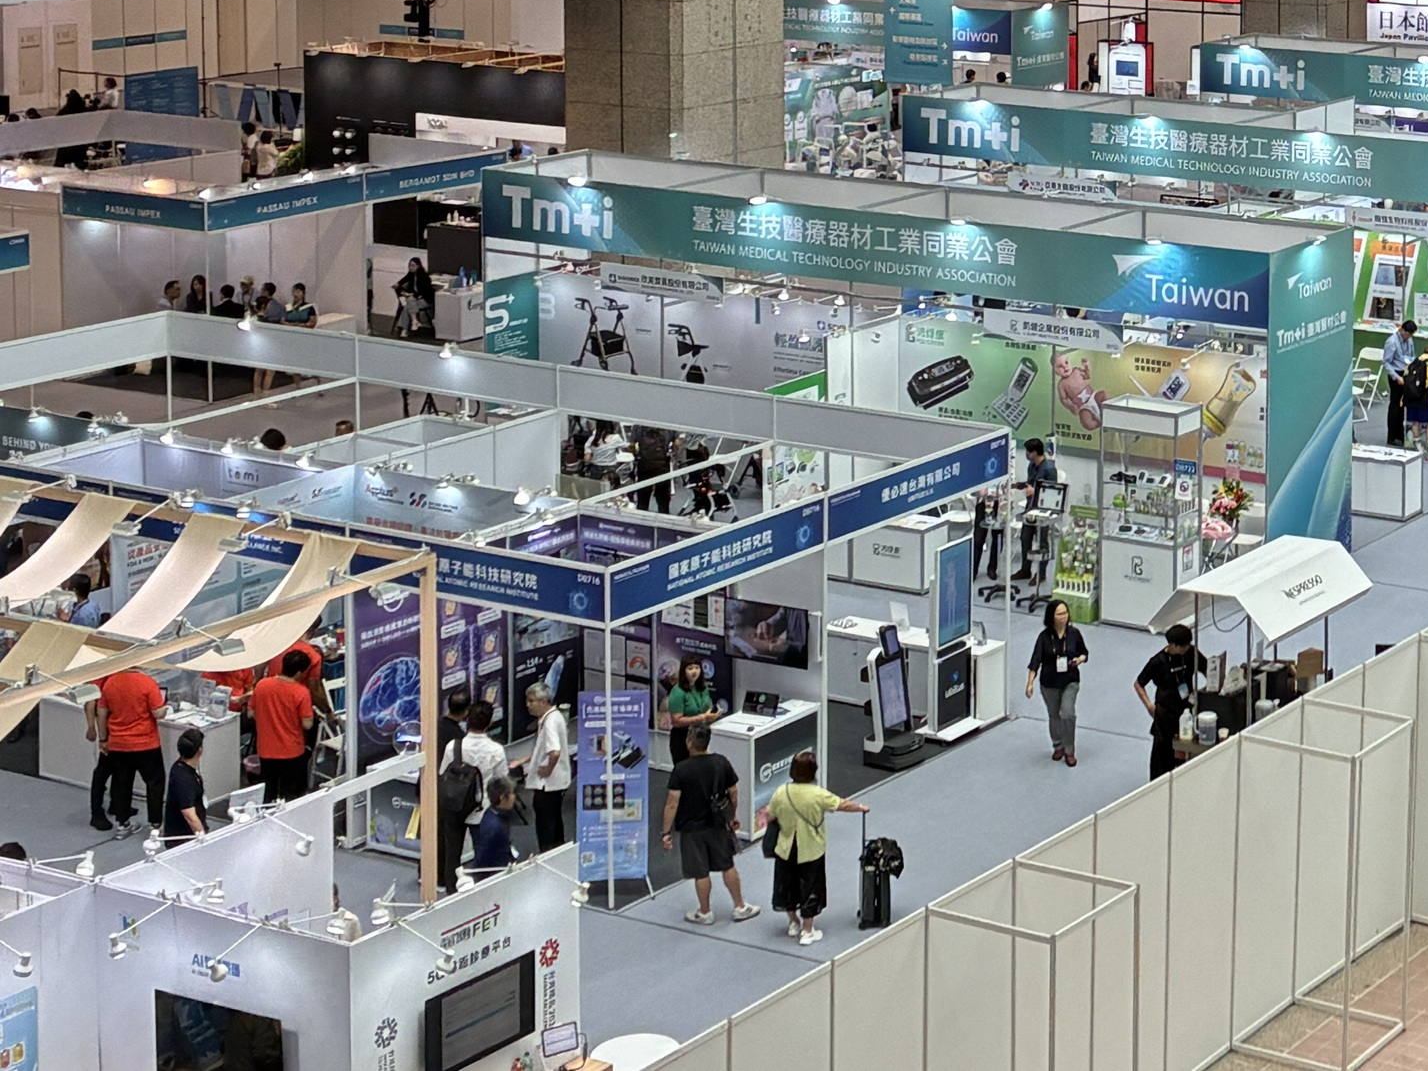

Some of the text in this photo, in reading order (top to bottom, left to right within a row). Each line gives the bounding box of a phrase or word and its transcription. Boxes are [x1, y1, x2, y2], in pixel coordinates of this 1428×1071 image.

[1380, 32, 1401, 40] Japan
[1090, 122, 1374, 170] 臺灣生技醫療器材工業同業公會
[1091, 151, 1372, 188] TAIWAN MEDICAL TECHNOLOGY INDUSTRY ASSOCIATION
[105, 205, 135, 216] PASSAU
[692, 205, 1018, 267] 臺灣生技醫療器材工業同業公會
[692, 240, 1016, 287] TAIWAN MEDICAL TECHNOLOGY INDUSTRY ASSOCIATION
[1145, 274, 1250, 313] Taiwan
[1298, 277, 1332, 299] Taiwan
[2, 436, 37, 449] BEHIND
[668, 530, 772, 580] 國家原子能科技研究院
[438, 557, 538, 590] 原子能科技研究院
[472, 912, 501, 938] FET
